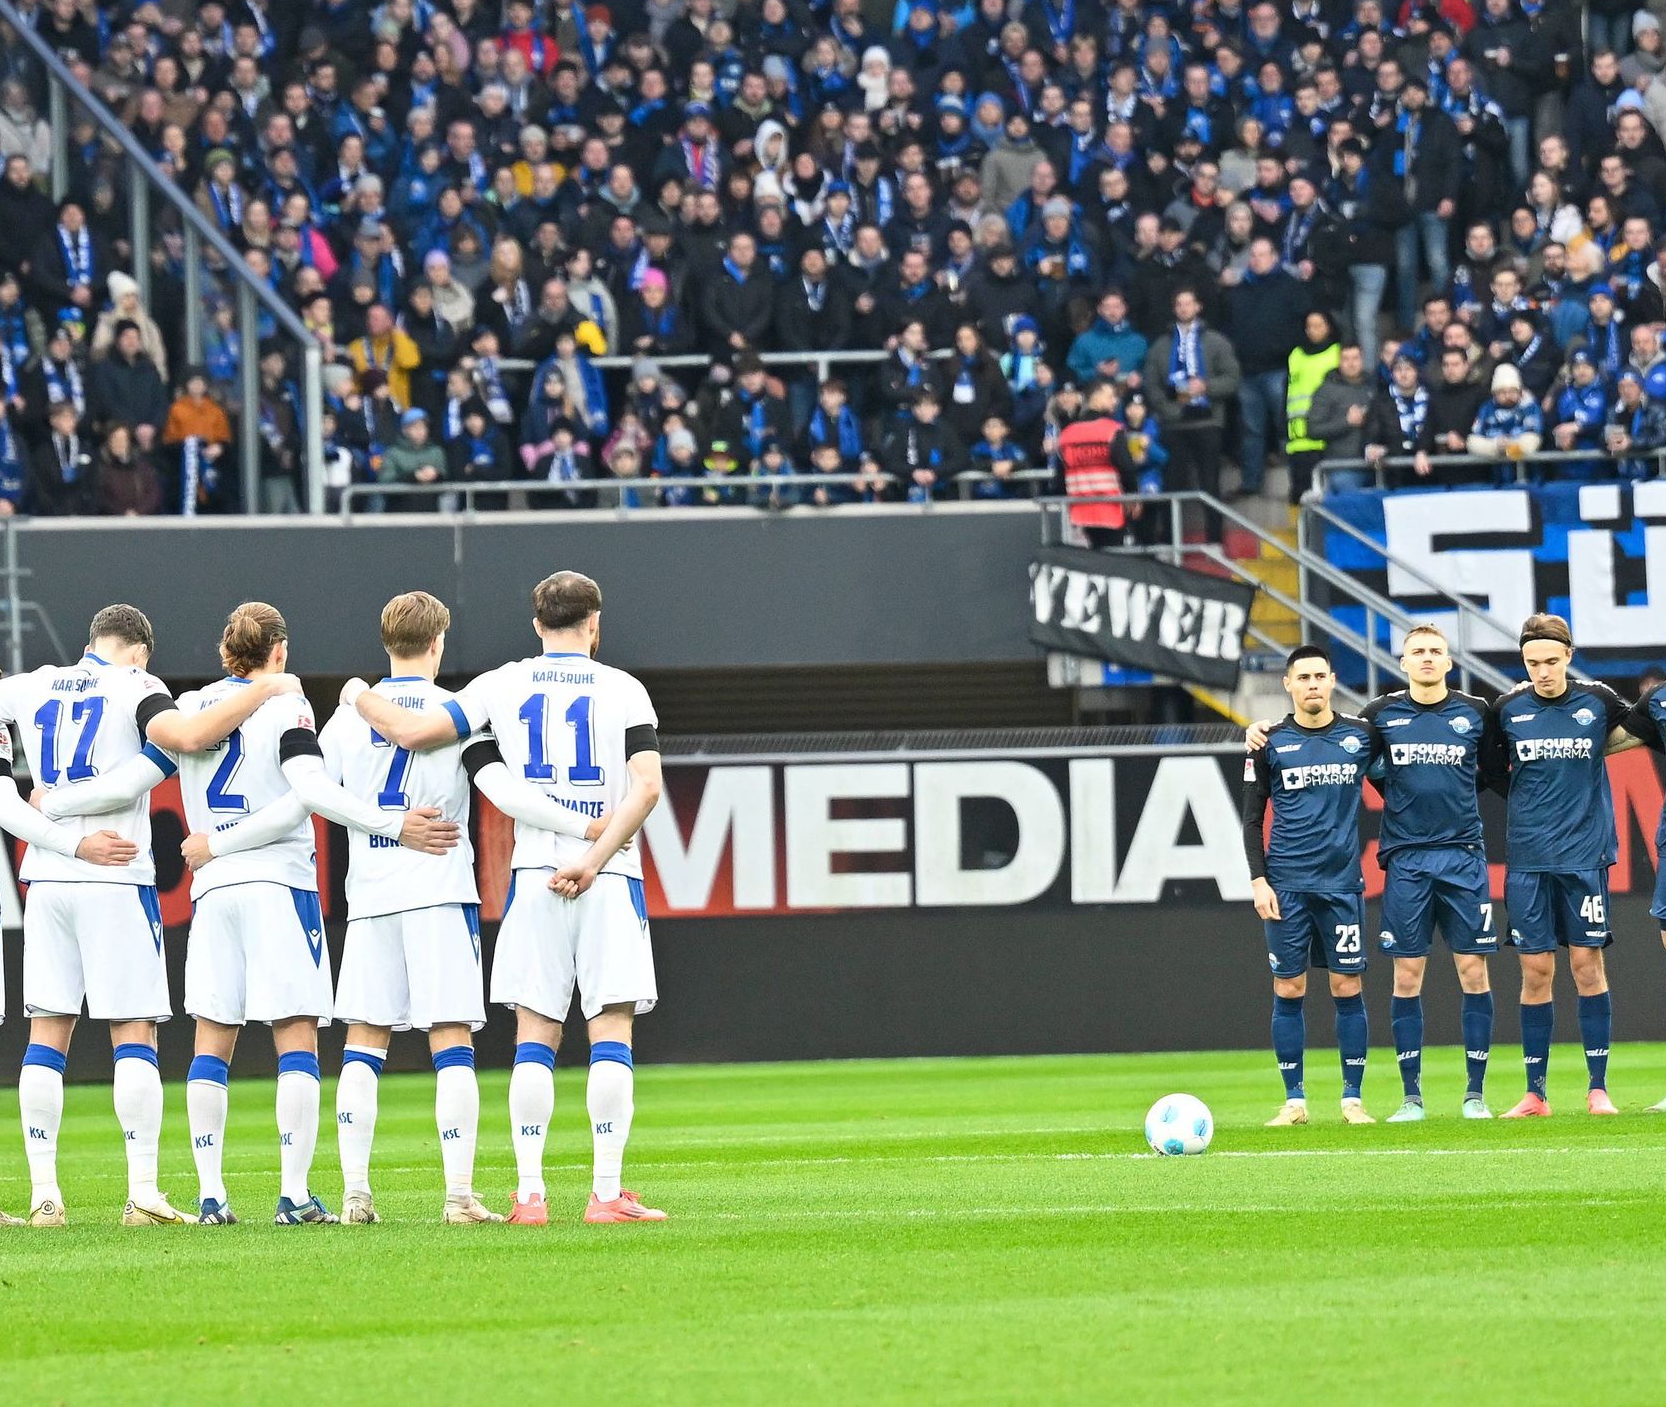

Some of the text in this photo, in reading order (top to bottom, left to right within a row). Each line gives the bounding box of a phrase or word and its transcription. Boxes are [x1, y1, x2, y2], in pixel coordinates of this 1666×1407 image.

[532, 670, 595, 685] KARLSRUHE
[34, 696, 108, 789] 17
[519, 693, 605, 786] 11
[1409, 754, 1462, 766] PHARMA
[1534, 747, 1590, 759] PHARMA
[205, 726, 250, 814] 2
[1303, 772, 1355, 785] PHARMA
[1580, 895, 1605, 923] 46
[1480, 903, 1492, 932] 7
[1335, 923, 1360, 953] 23
[29, 1126, 48, 1140] KSC
[442, 1128, 460, 1140] KSC
[521, 1124, 541, 1137] KSC
[596, 1121, 613, 1134] KSC
[195, 1133, 214, 1148] KSC
